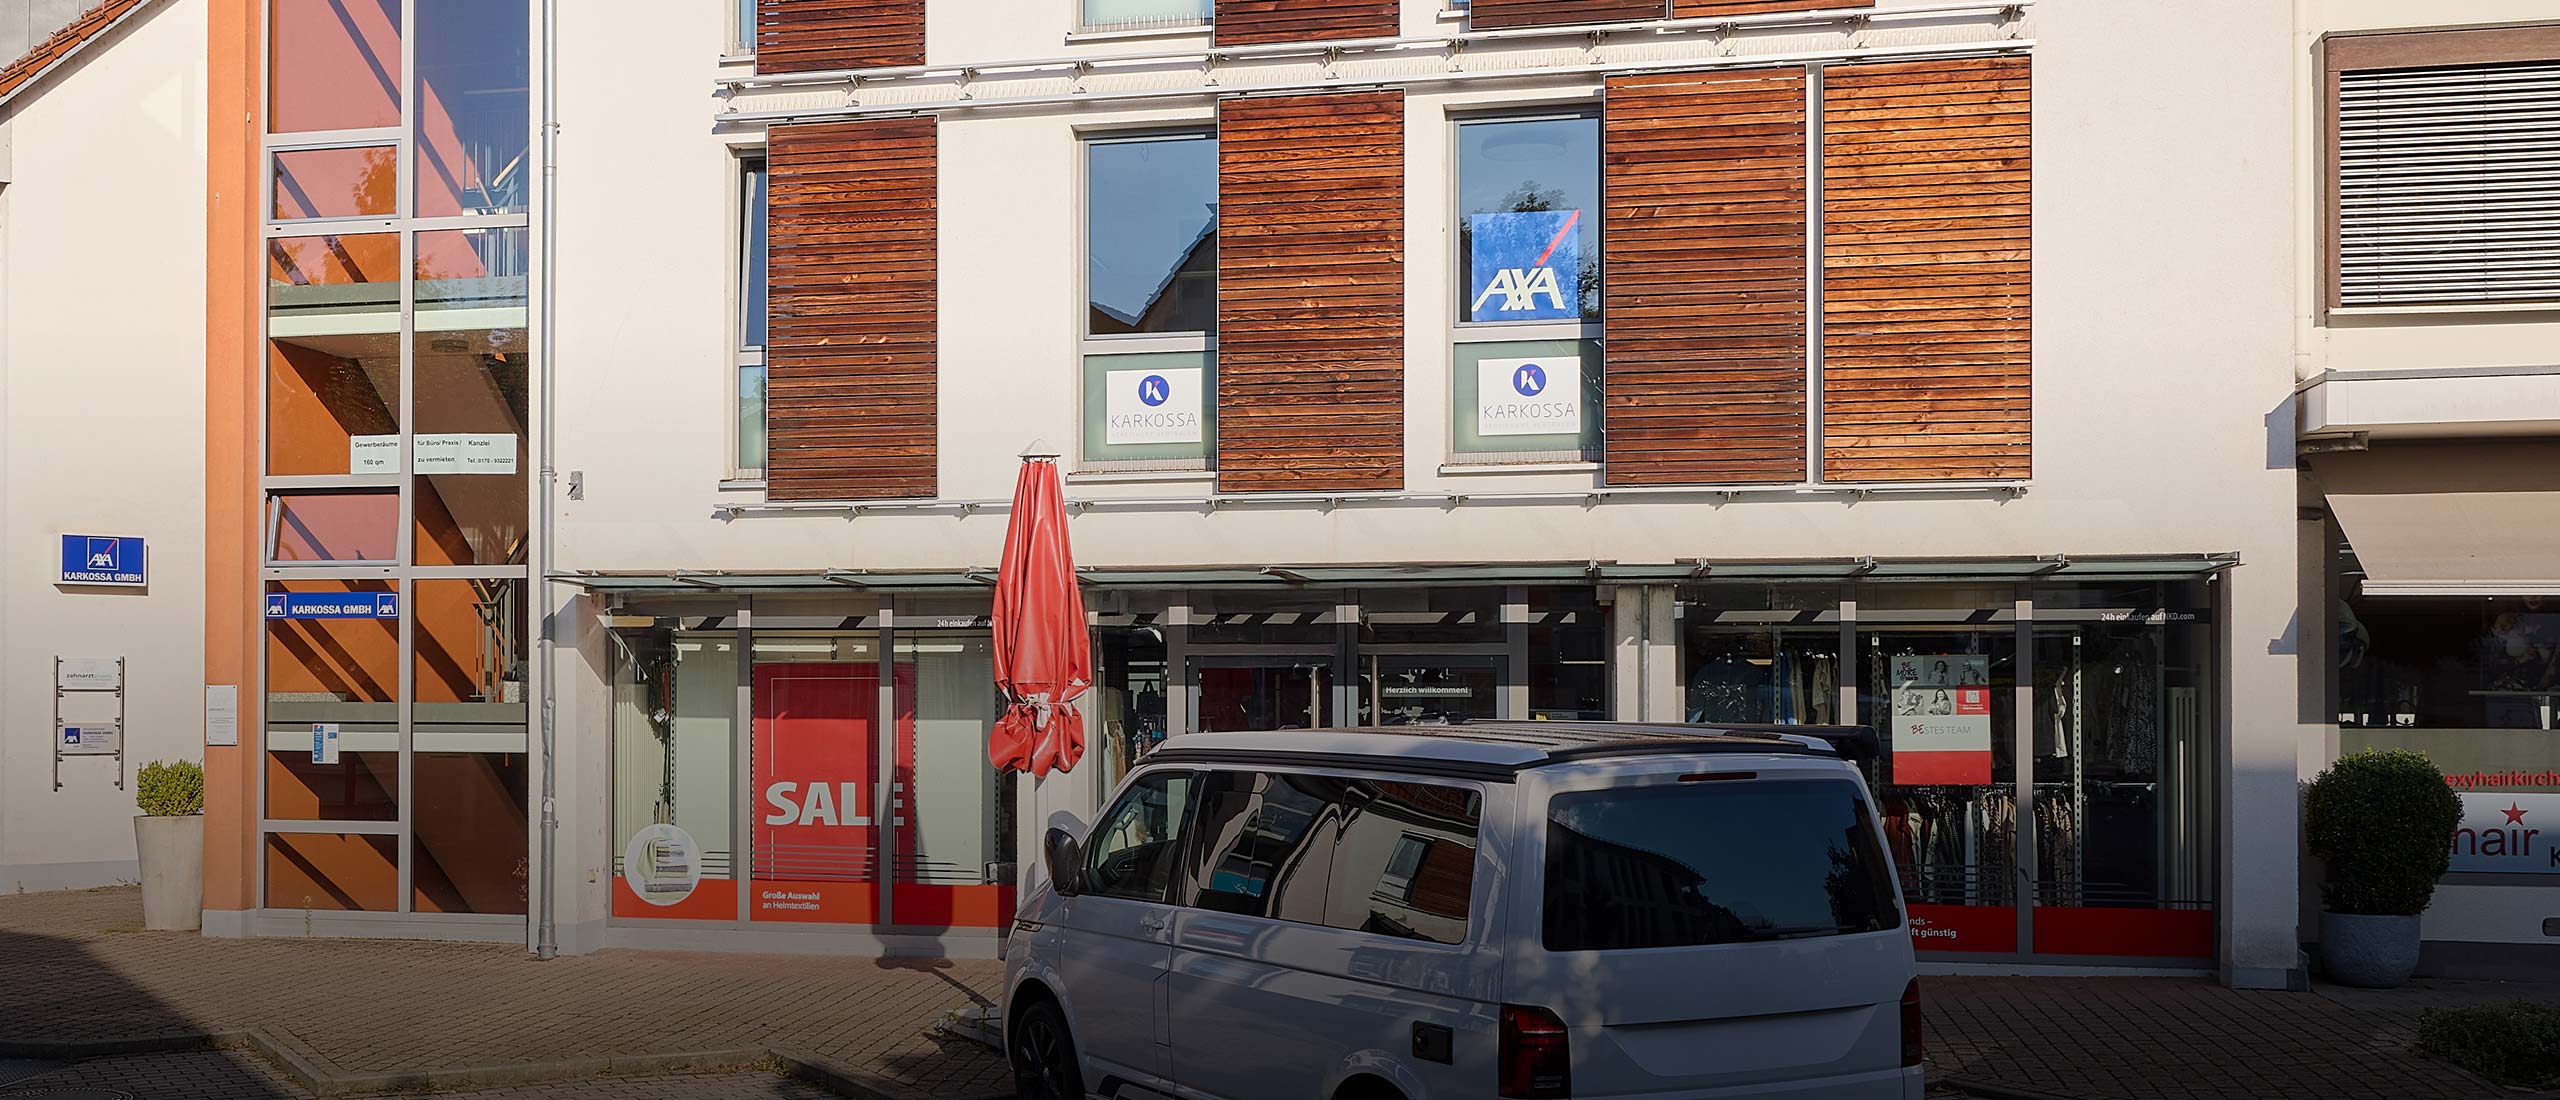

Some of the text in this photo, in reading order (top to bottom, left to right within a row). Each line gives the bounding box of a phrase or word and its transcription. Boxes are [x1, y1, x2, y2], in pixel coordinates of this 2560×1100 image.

[1472, 267, 1566, 311] AXA
[1484, 403, 1575, 419] KARKOSSA
[1111, 412, 1197, 428] KARKOSSA
[88, 553, 113, 566] AXA
[64, 572, 141, 582] KARKOSSA GMBH
[267, 605, 283, 614] AXA
[291, 605, 372, 614] KARKOSSA GMBH
[379, 604, 395, 613] AXA
[1947, 726, 1971, 734] TEAM
[2444, 769, 2560, 790] exyhairkirch
[766, 782, 905, 826] SALE
[2453, 822, 2540, 856] hair
[762, 891, 820, 901] Große Auswahl
[772, 902, 820, 910] Heimtextilien
[1909, 917, 1926, 925] nds
[1911, 928, 1957, 939] ft günstig
